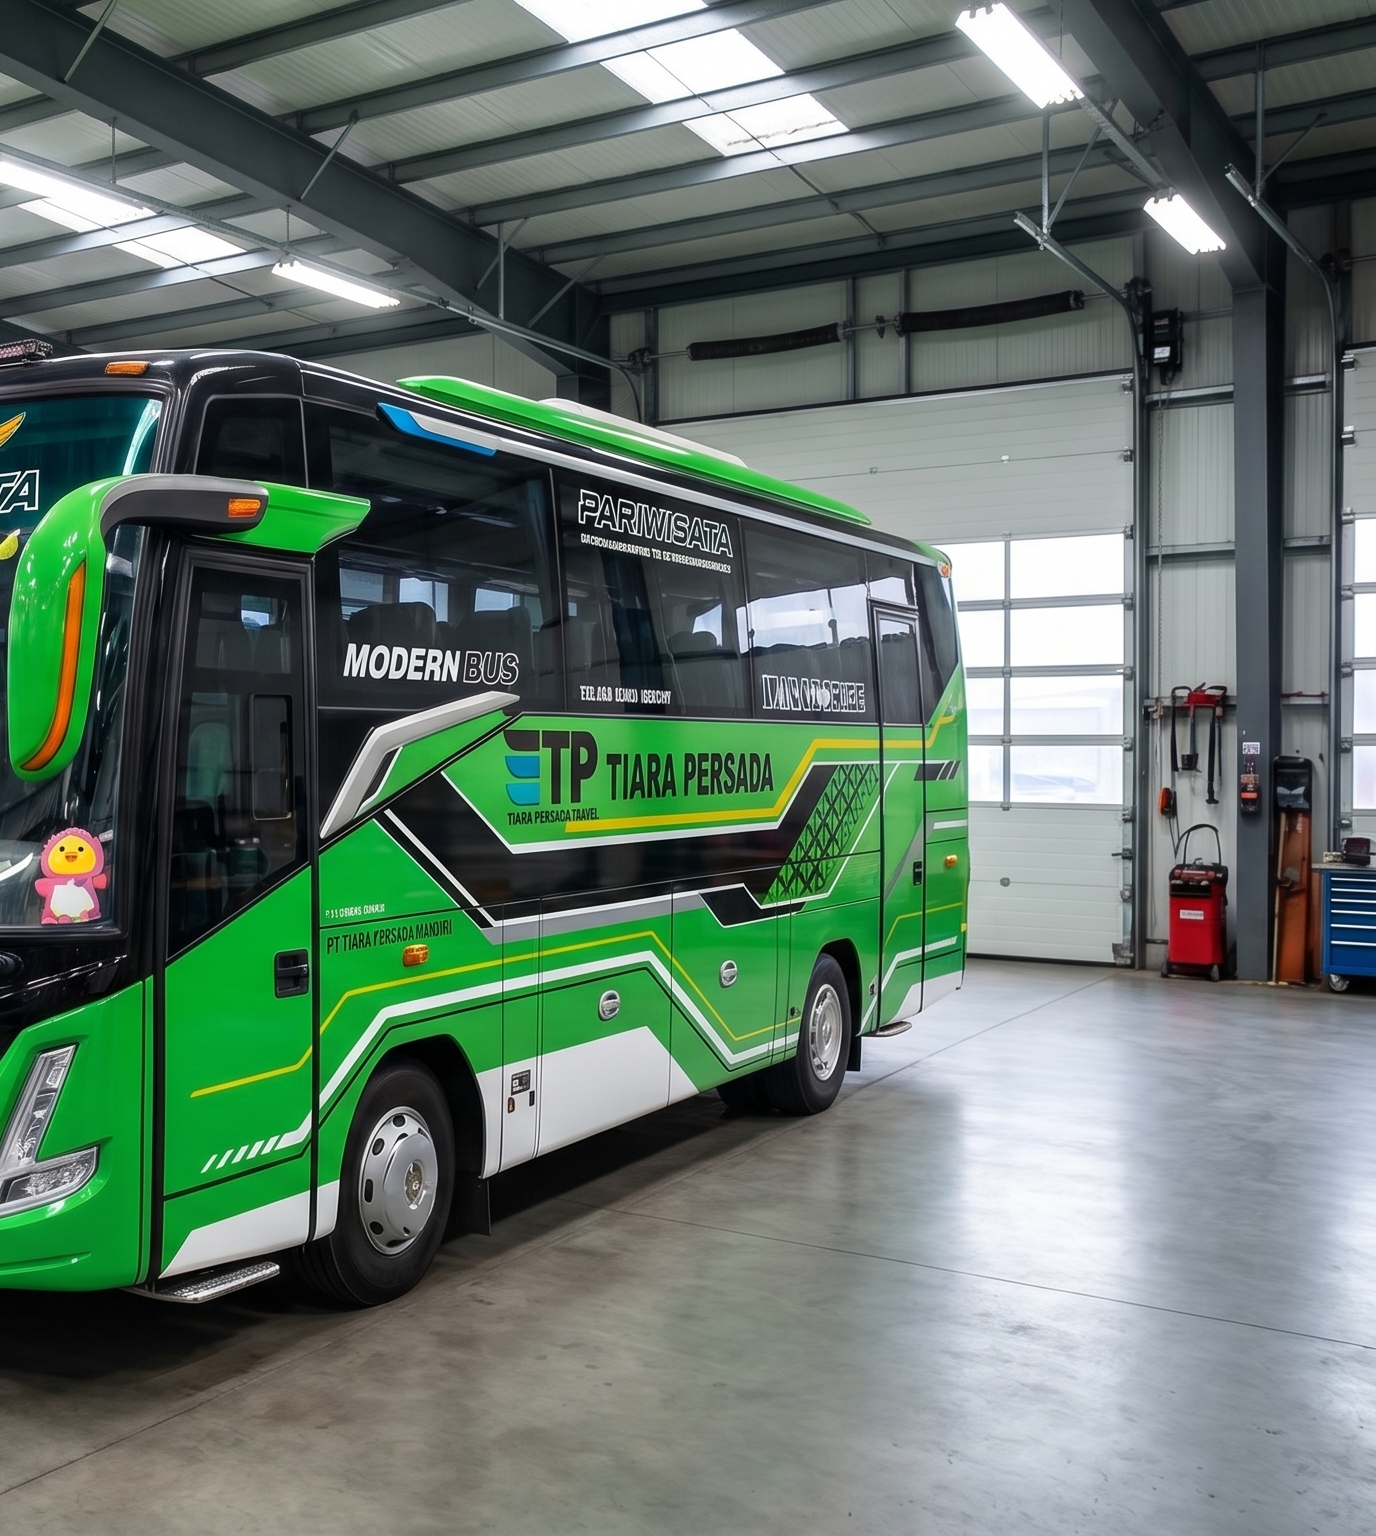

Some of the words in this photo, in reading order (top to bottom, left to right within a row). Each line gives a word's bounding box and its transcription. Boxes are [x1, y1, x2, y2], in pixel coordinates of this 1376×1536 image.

[578, 489, 733, 557] PARIWISATA
[343, 643, 460, 682] MODERN
[463, 651, 519, 685] BUS
[606, 753, 677, 800] TIARA
[684, 752, 774, 797] PERSADA
[507, 811, 533, 826] TIARA
[327, 936, 340, 954] PT
[342, 931, 371, 952] TIARA
